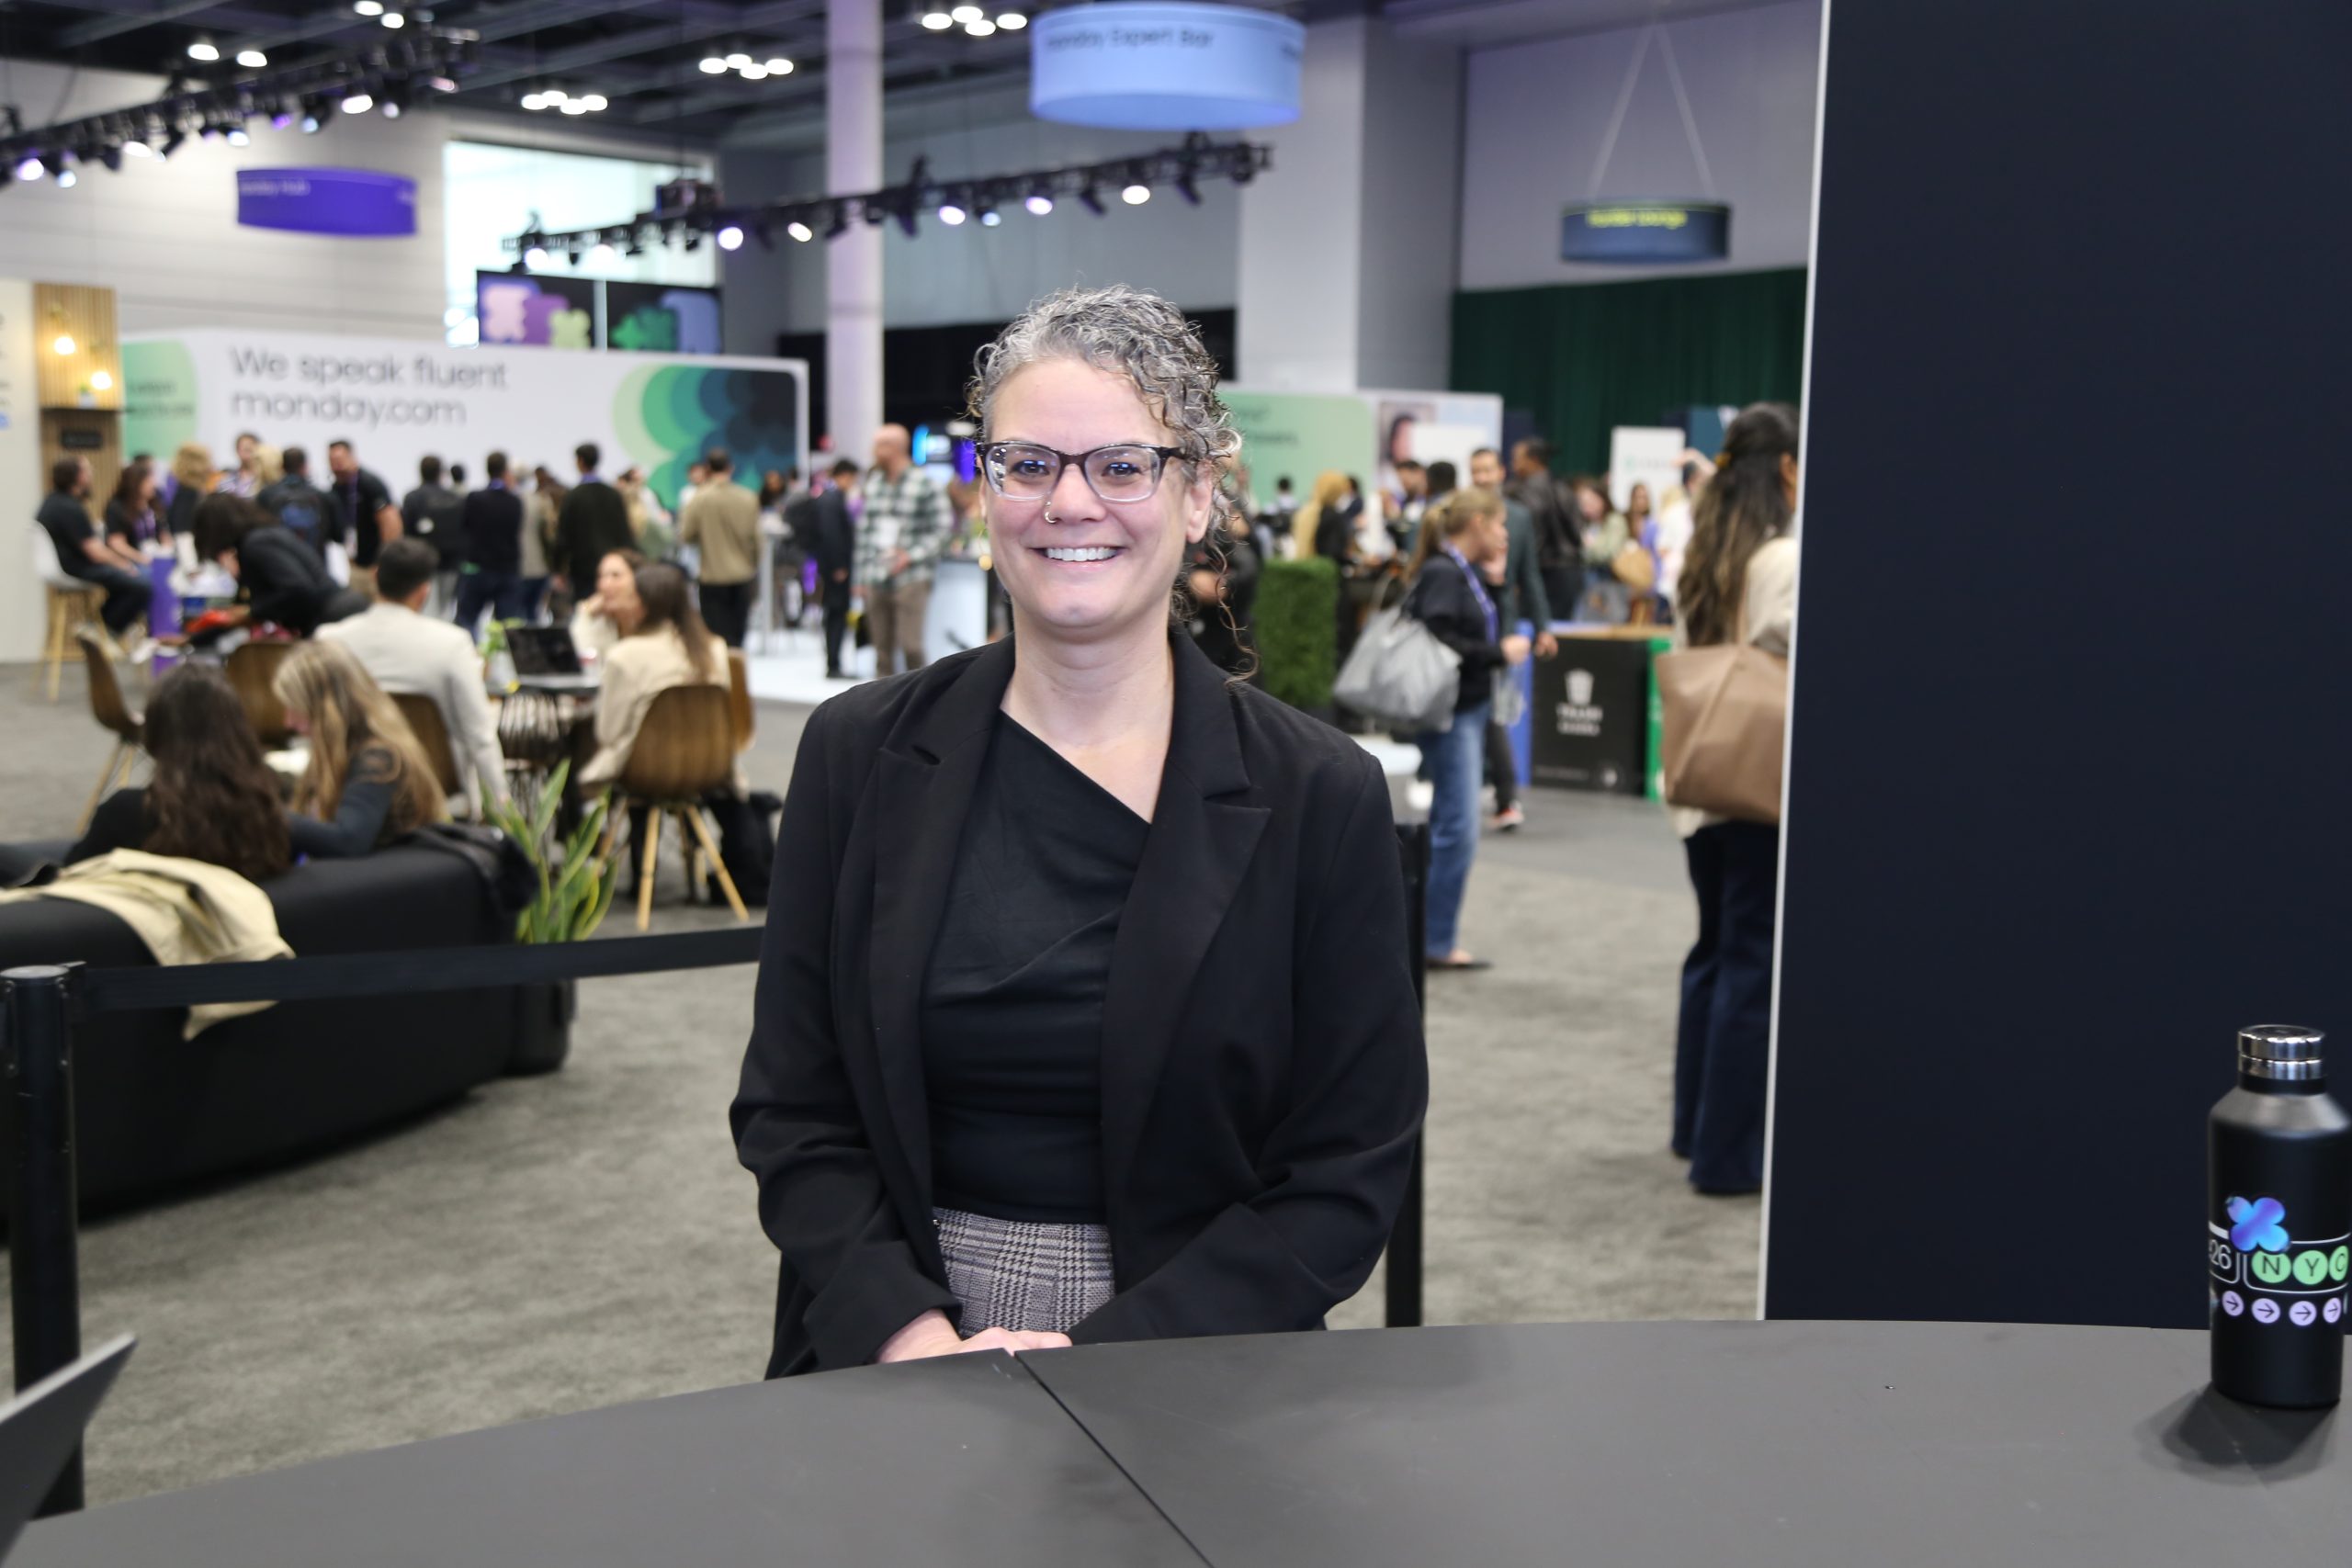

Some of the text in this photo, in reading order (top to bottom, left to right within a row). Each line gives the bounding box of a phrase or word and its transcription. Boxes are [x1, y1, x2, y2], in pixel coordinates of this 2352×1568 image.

[1111, 28, 1173, 48] Expert
[1180, 29, 1214, 49] Bar
[230, 347, 509, 389] We speak fluent
[230, 391, 467, 429] monday.com
